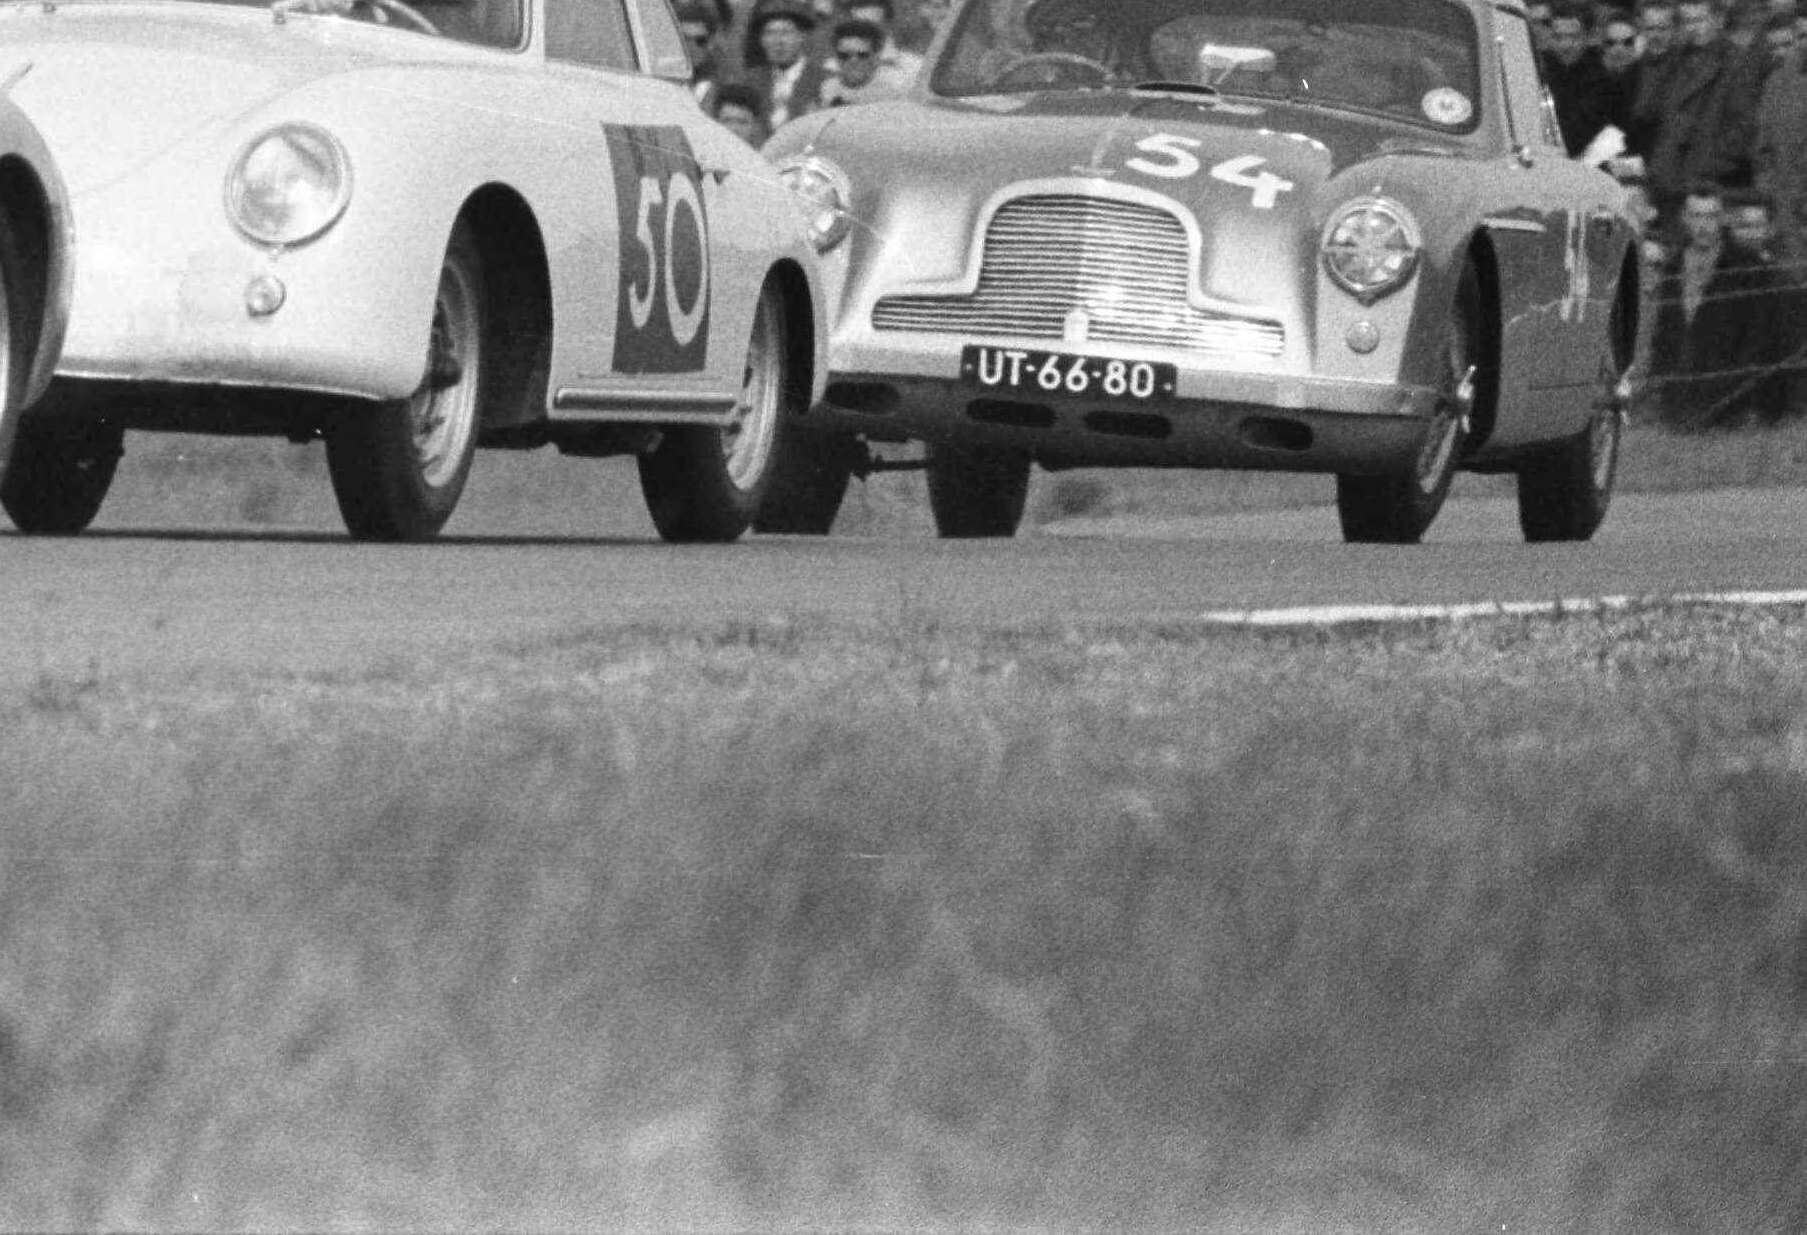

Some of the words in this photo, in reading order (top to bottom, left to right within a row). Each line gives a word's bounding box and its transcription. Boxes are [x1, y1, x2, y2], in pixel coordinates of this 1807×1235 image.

[1125, 132, 1294, 209] 54
[628, 171, 708, 347] 50
[979, 348, 1155, 399] UT-66-80
